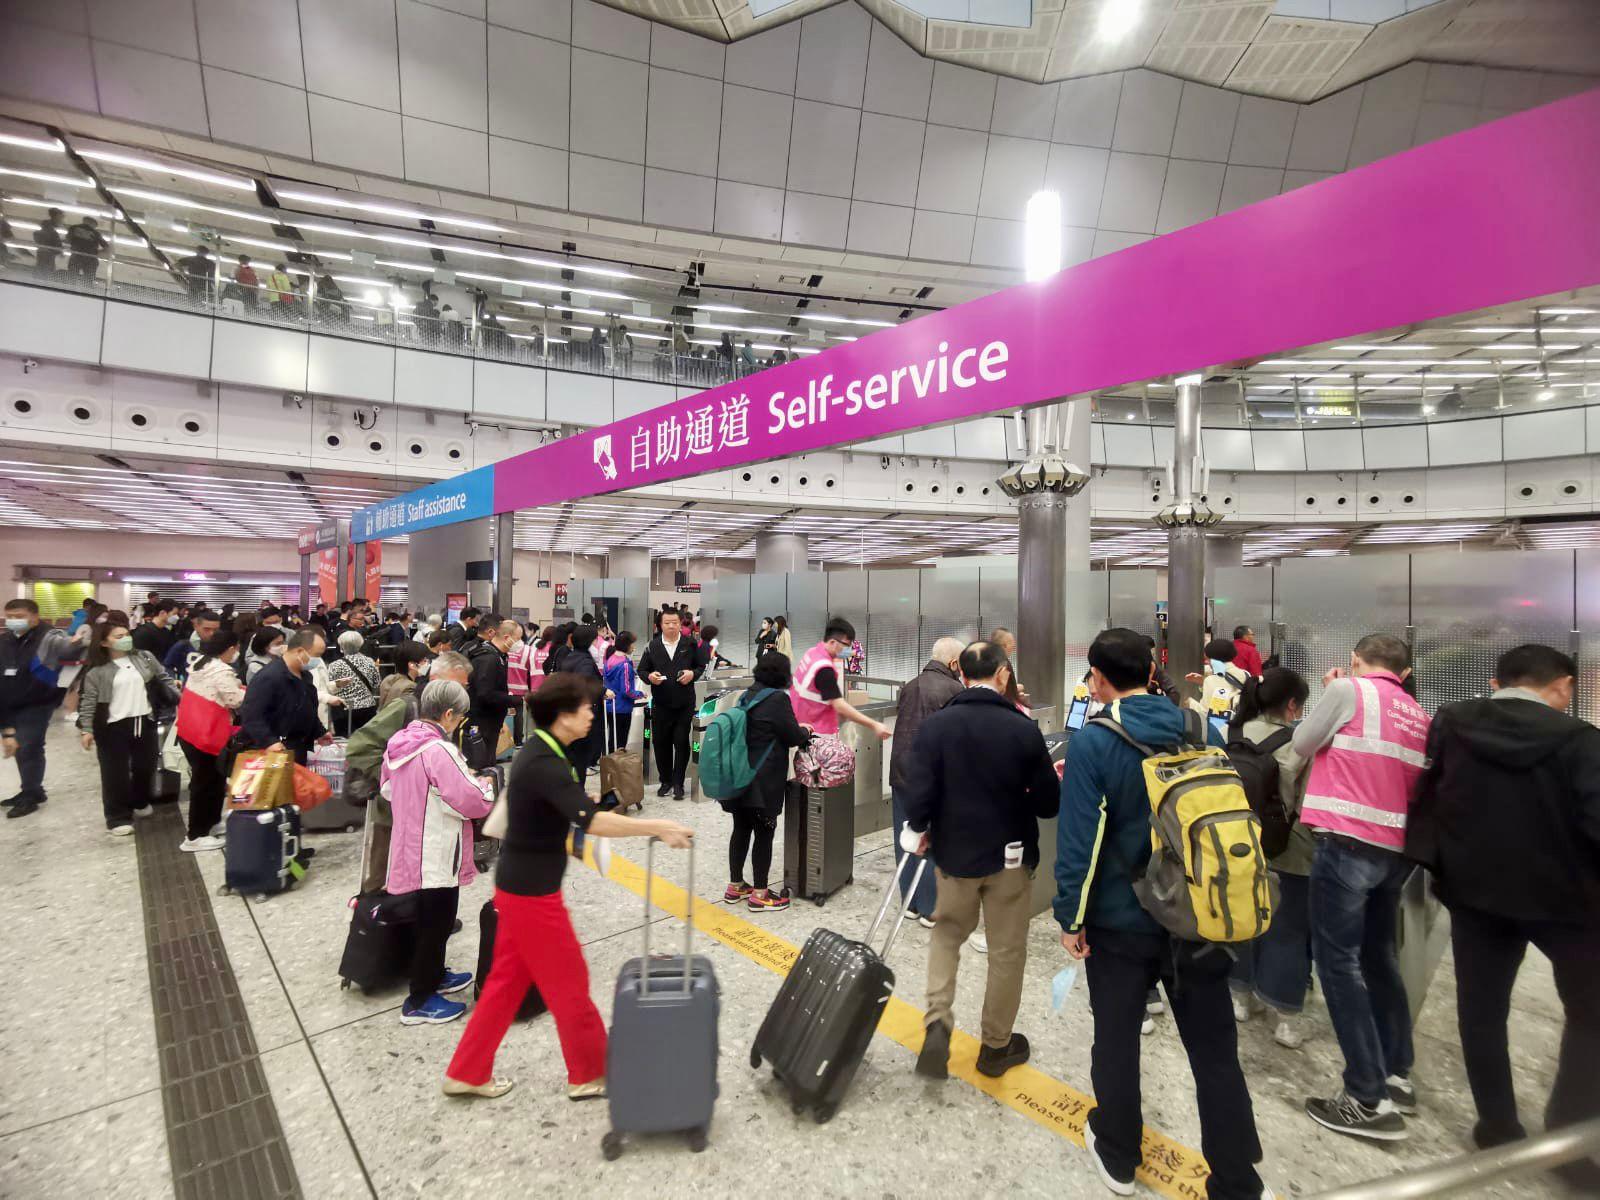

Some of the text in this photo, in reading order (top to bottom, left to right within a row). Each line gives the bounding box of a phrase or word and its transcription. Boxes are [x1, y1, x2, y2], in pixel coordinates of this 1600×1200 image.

[629, 340, 1009, 472] 自助通道 Self-service
[407, 499, 424, 522] Staff
[424, 492, 466, 518] assistance
[713, 927, 736, 941] Please
[735, 939, 754, 951] wait
[752, 948, 780, 967] behind
[1015, 1092, 1065, 1124] Please
